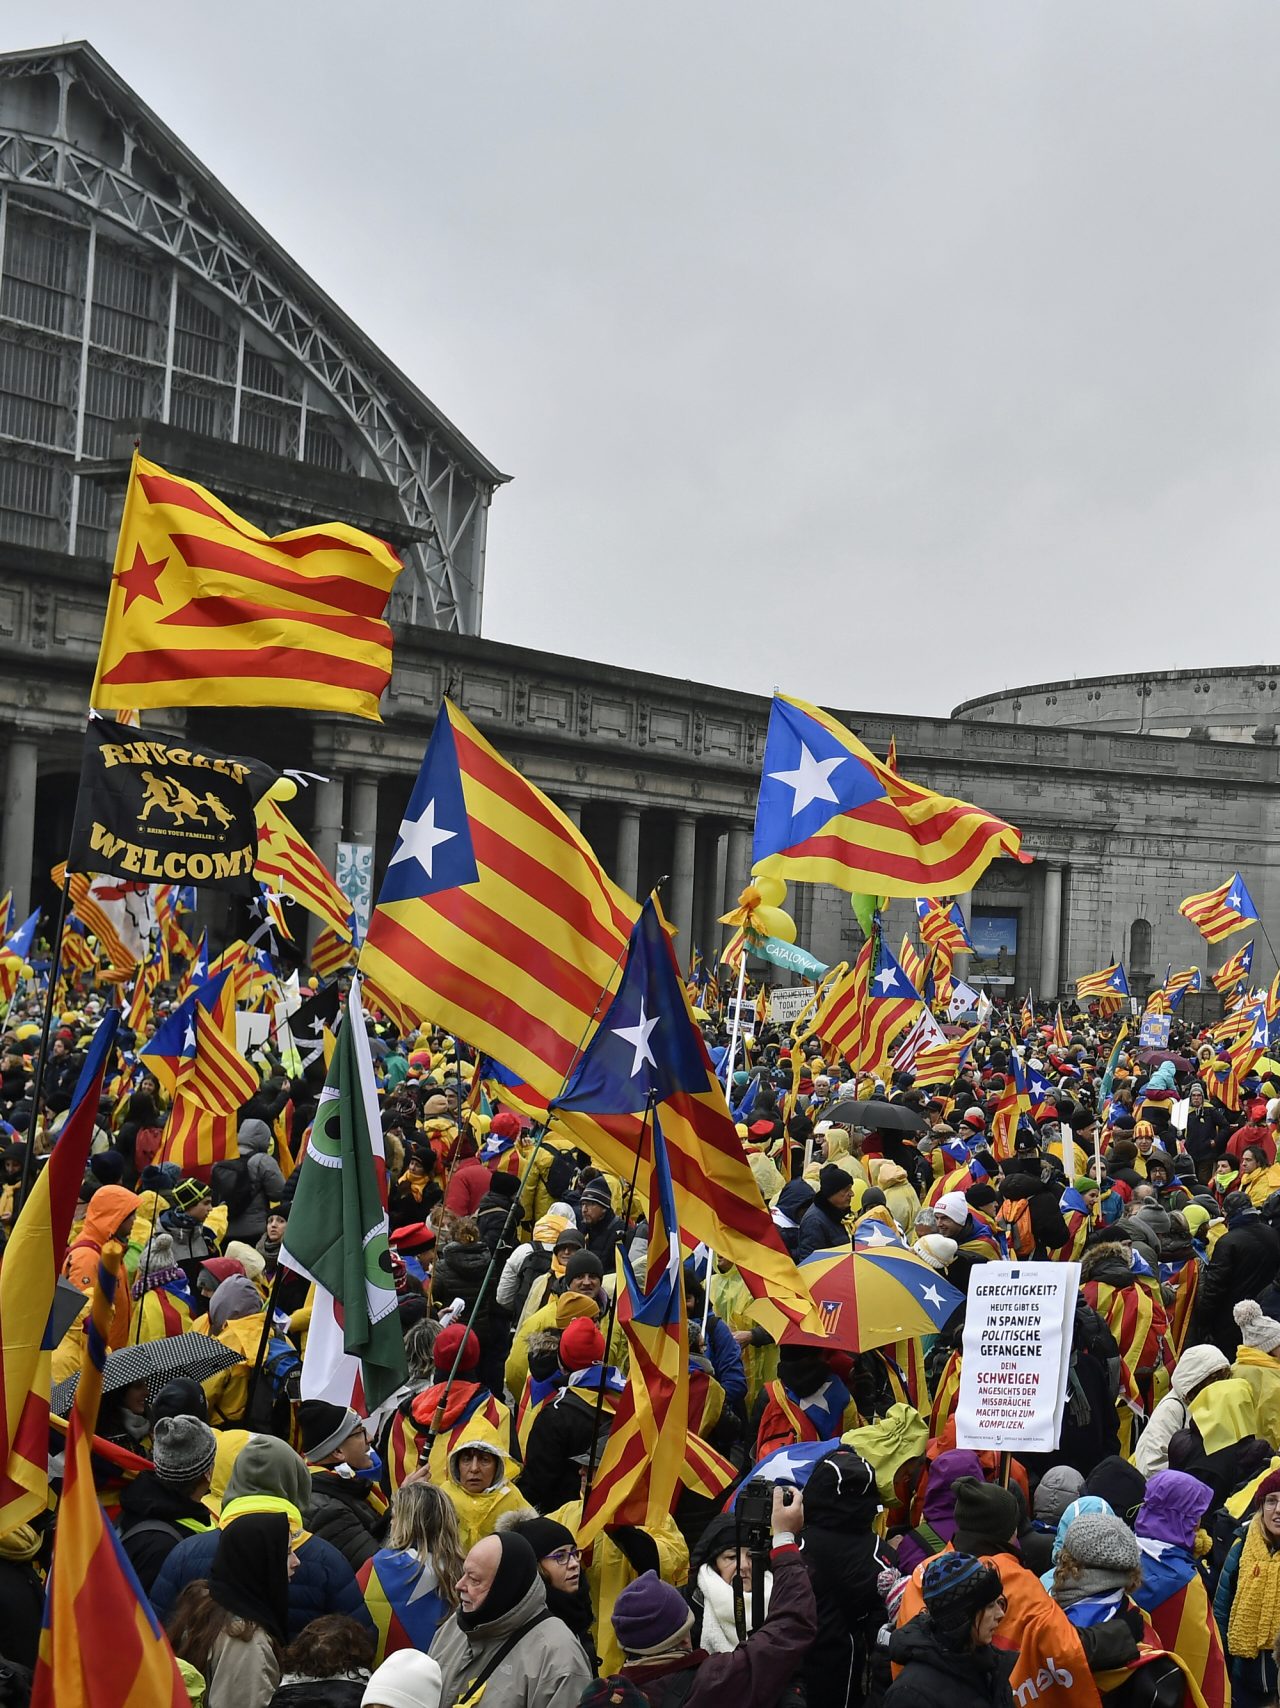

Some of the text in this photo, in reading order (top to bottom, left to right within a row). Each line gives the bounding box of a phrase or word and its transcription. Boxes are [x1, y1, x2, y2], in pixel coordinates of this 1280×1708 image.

[146, 827, 215, 841] BRING YOUR FAMILIES
[765, 943, 817, 973] CATALONIA
[779, 1001, 797, 1010] TODAY
[976, 1284, 1058, 1297] GERECHTIGKEIT?
[990, 1303, 1040, 1312] HEUTE GIBT ES
[986, 1315, 1041, 1327] IN SPANIEN
[981, 1329, 1041, 1342] POLITISCHE
[980, 1344, 1043, 1357] GEFANGENE
[1000, 1361, 1017, 1370] DEIN
[977, 1372, 1040, 1385] SCHWEIGEN
[978, 1387, 1037, 1396] ANGESICHTS DER
[981, 1396, 1031, 1407] MISSBRÄUCHE
[976, 1408, 1035, 1418] MACHT DICH ZUM
[978, 1419, 1026, 1430] KOMPLIZEN.
